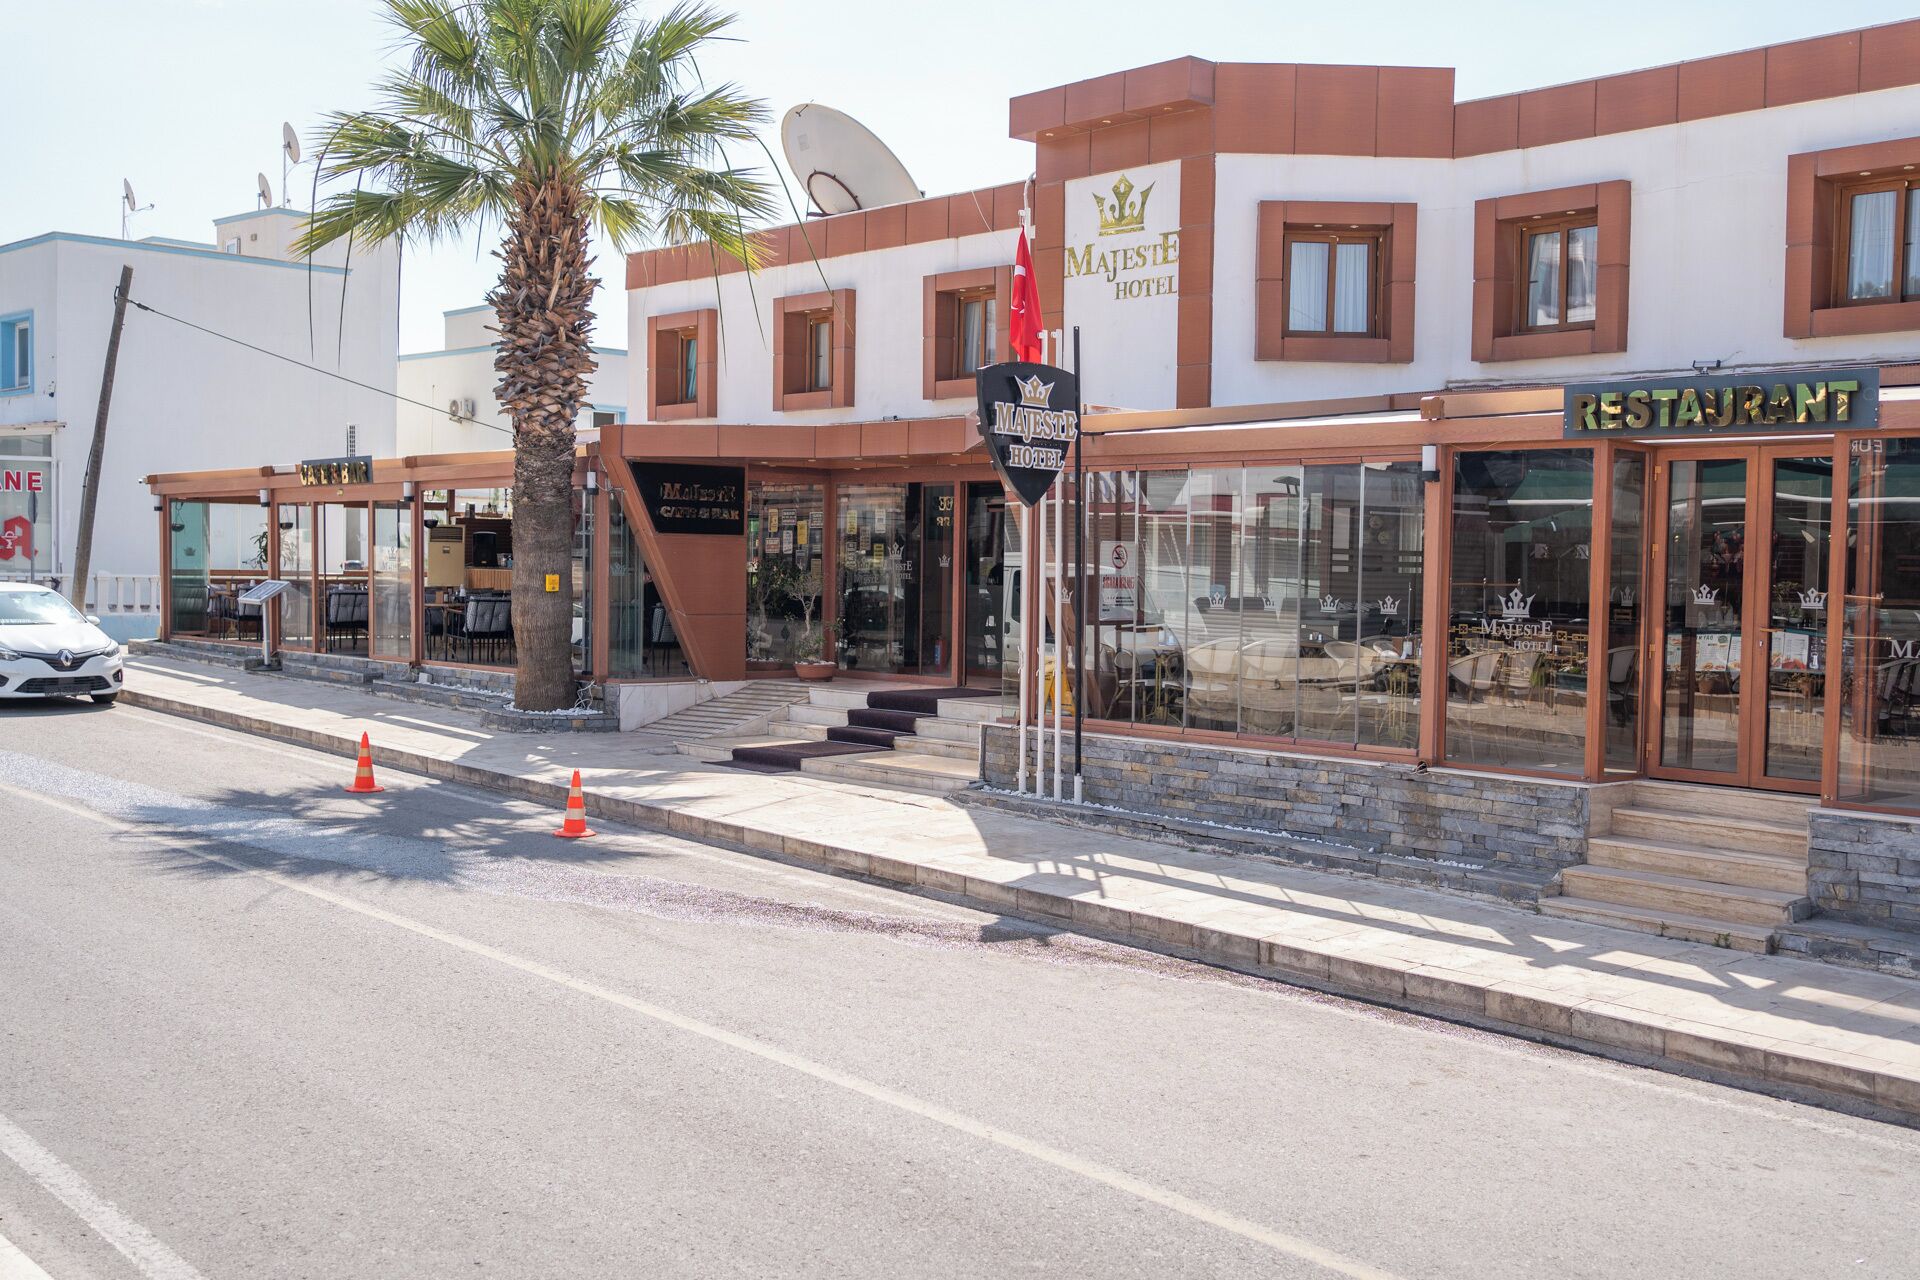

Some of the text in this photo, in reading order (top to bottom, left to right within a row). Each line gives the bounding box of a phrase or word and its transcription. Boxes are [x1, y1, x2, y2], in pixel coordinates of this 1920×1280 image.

[1063, 230, 1180, 283] MAJESTE
[1113, 275, 1178, 301] HOTEL
[1572, 379, 1859, 431] RESTAURANT
[994, 401, 1078, 443] MAJESTE
[1009, 444, 1066, 471] HOTEL
[0, 470, 43, 492] NE
[1480, 618, 1553, 640] MAJESTE
[1513, 640, 1552, 652] HOTEL
